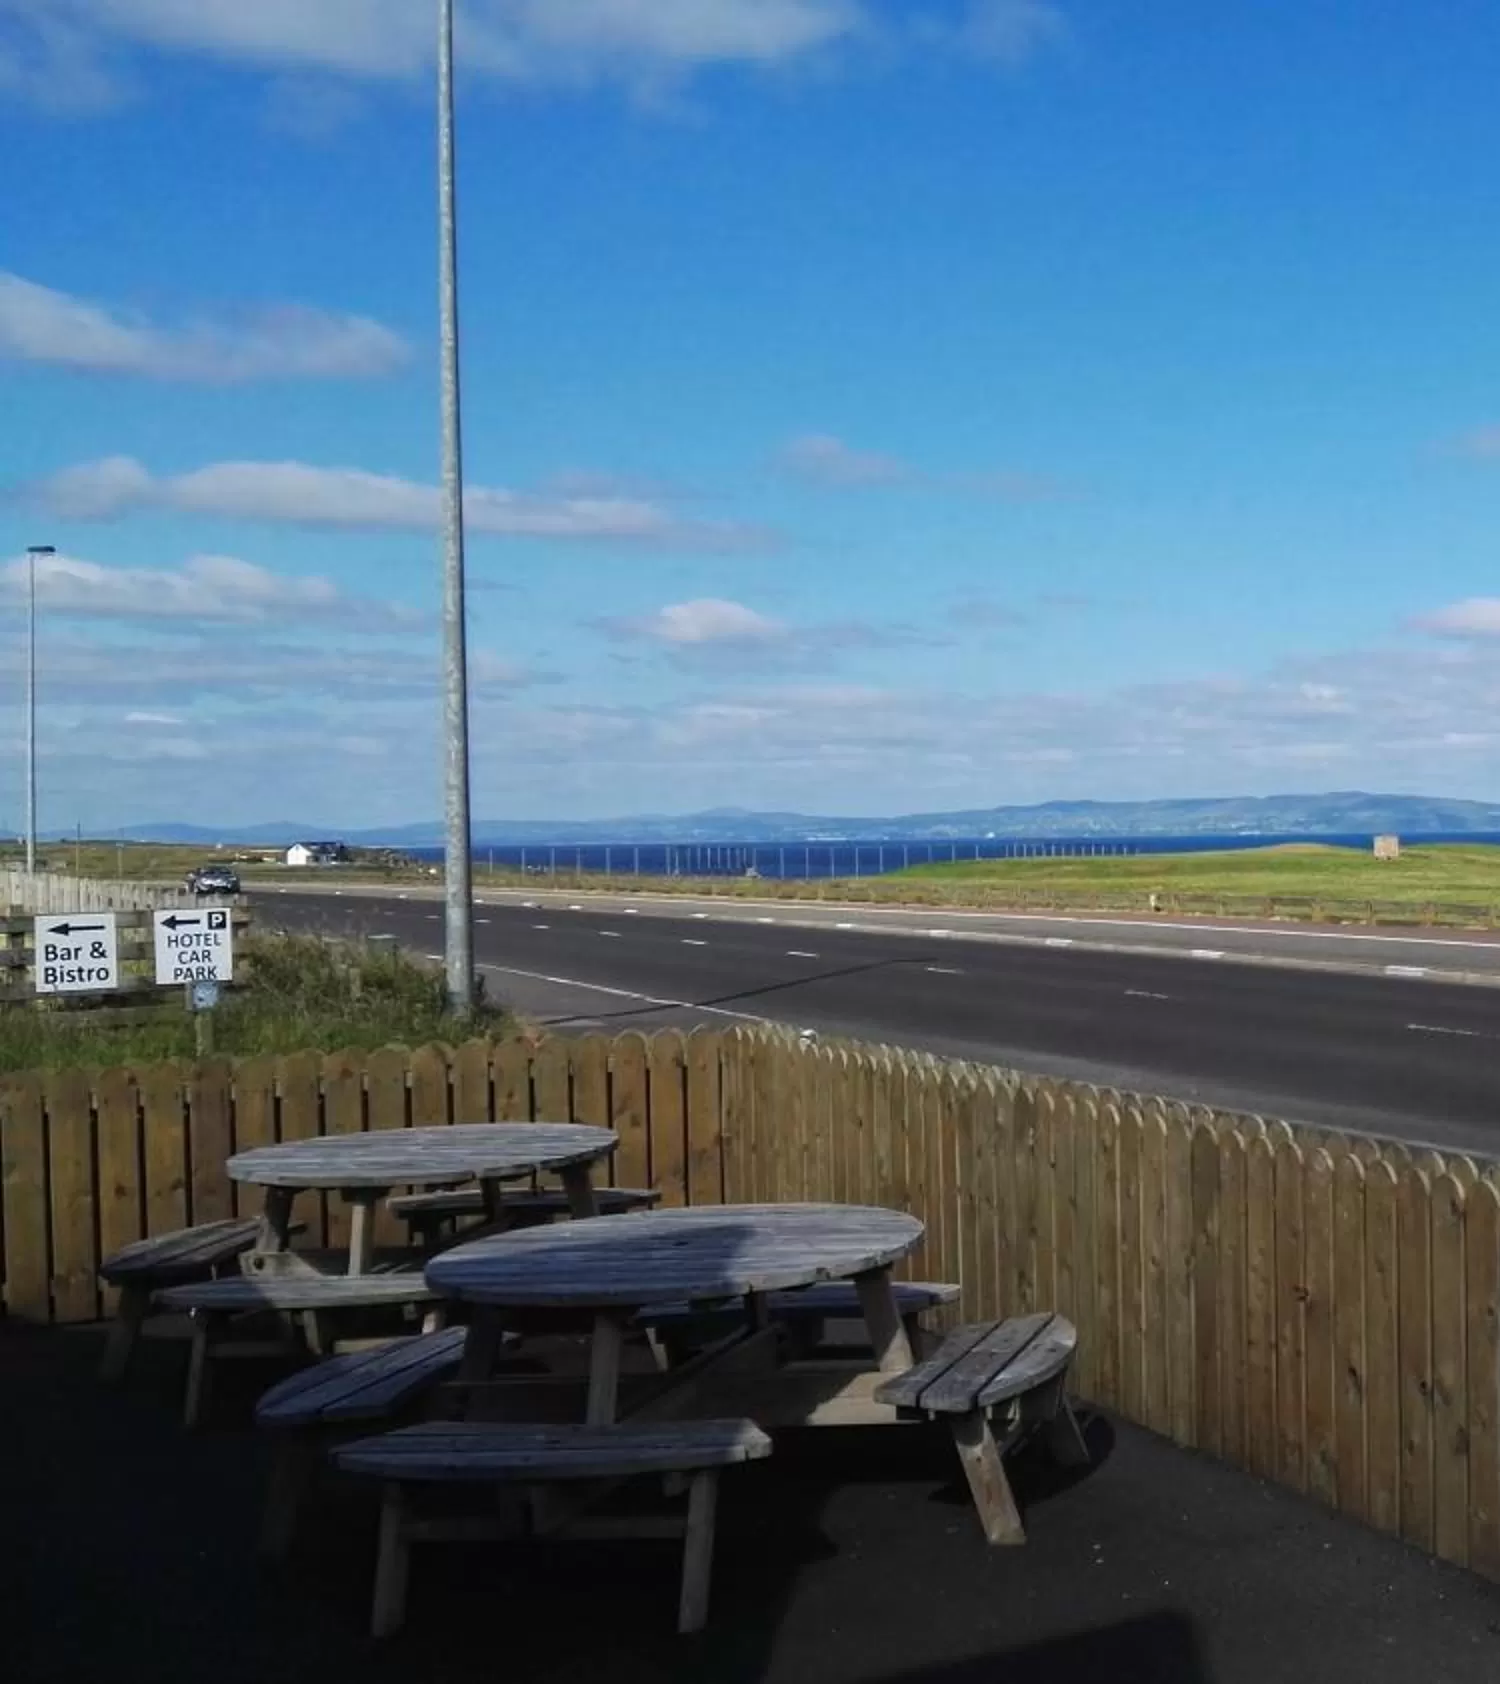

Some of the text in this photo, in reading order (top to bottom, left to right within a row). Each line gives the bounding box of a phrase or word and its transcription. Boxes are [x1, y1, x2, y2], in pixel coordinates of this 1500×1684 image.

[210, 914, 224, 927] P
[167, 933, 222, 948] HOTEL
[44, 941, 107, 962] Bar &
[177, 950, 212, 965] CAR
[44, 965, 109, 985] Bistro
[173, 966, 217, 981] PARK
